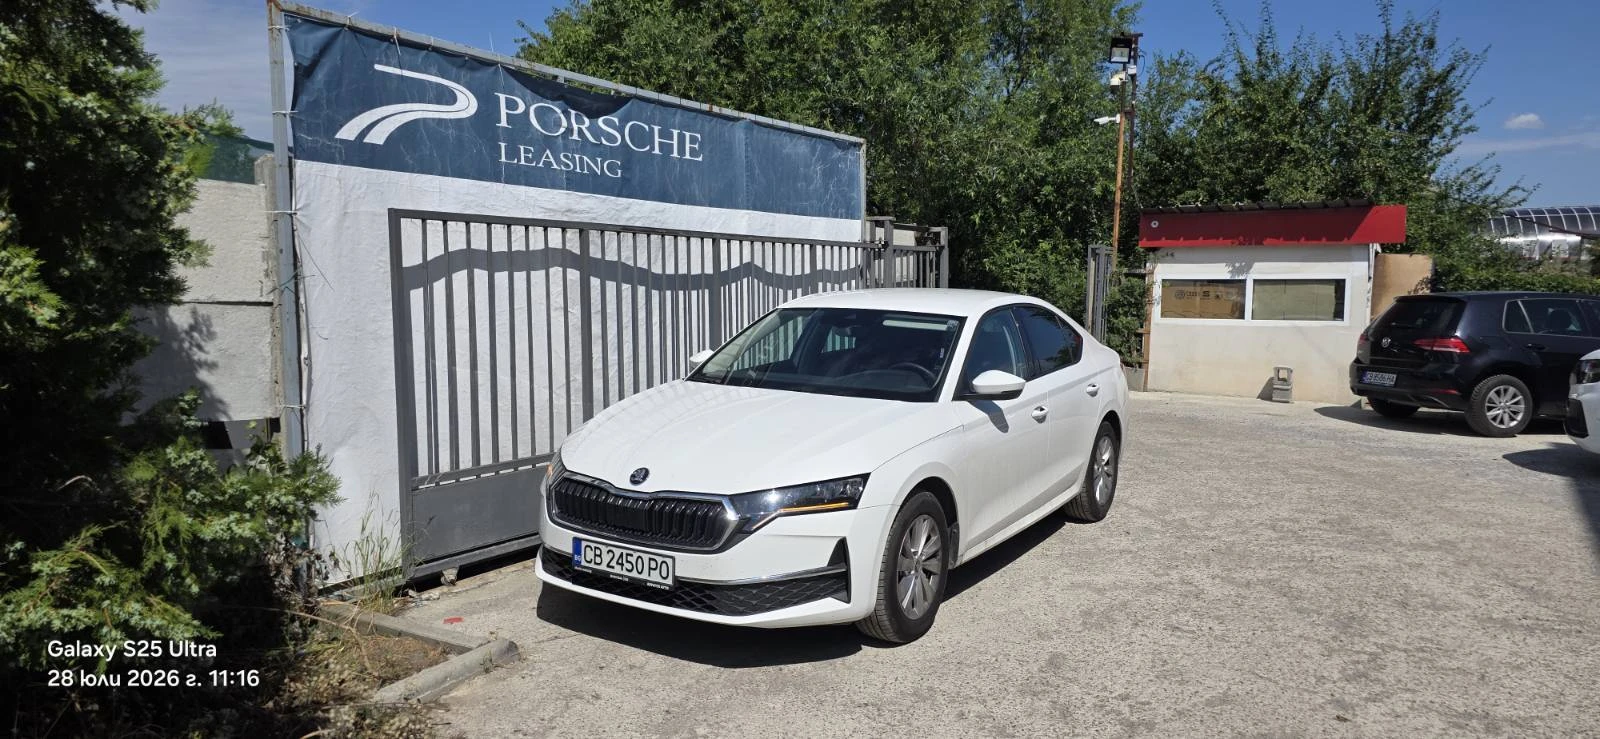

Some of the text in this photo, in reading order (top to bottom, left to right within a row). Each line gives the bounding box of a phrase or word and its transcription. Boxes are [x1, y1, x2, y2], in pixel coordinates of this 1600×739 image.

[493, 92, 704, 162] PORSCHE
[498, 142, 623, 178] LEASING
[583, 544, 603, 567] CB
[606, 549, 645, 575] 2450
[648, 557, 670, 581] PO
